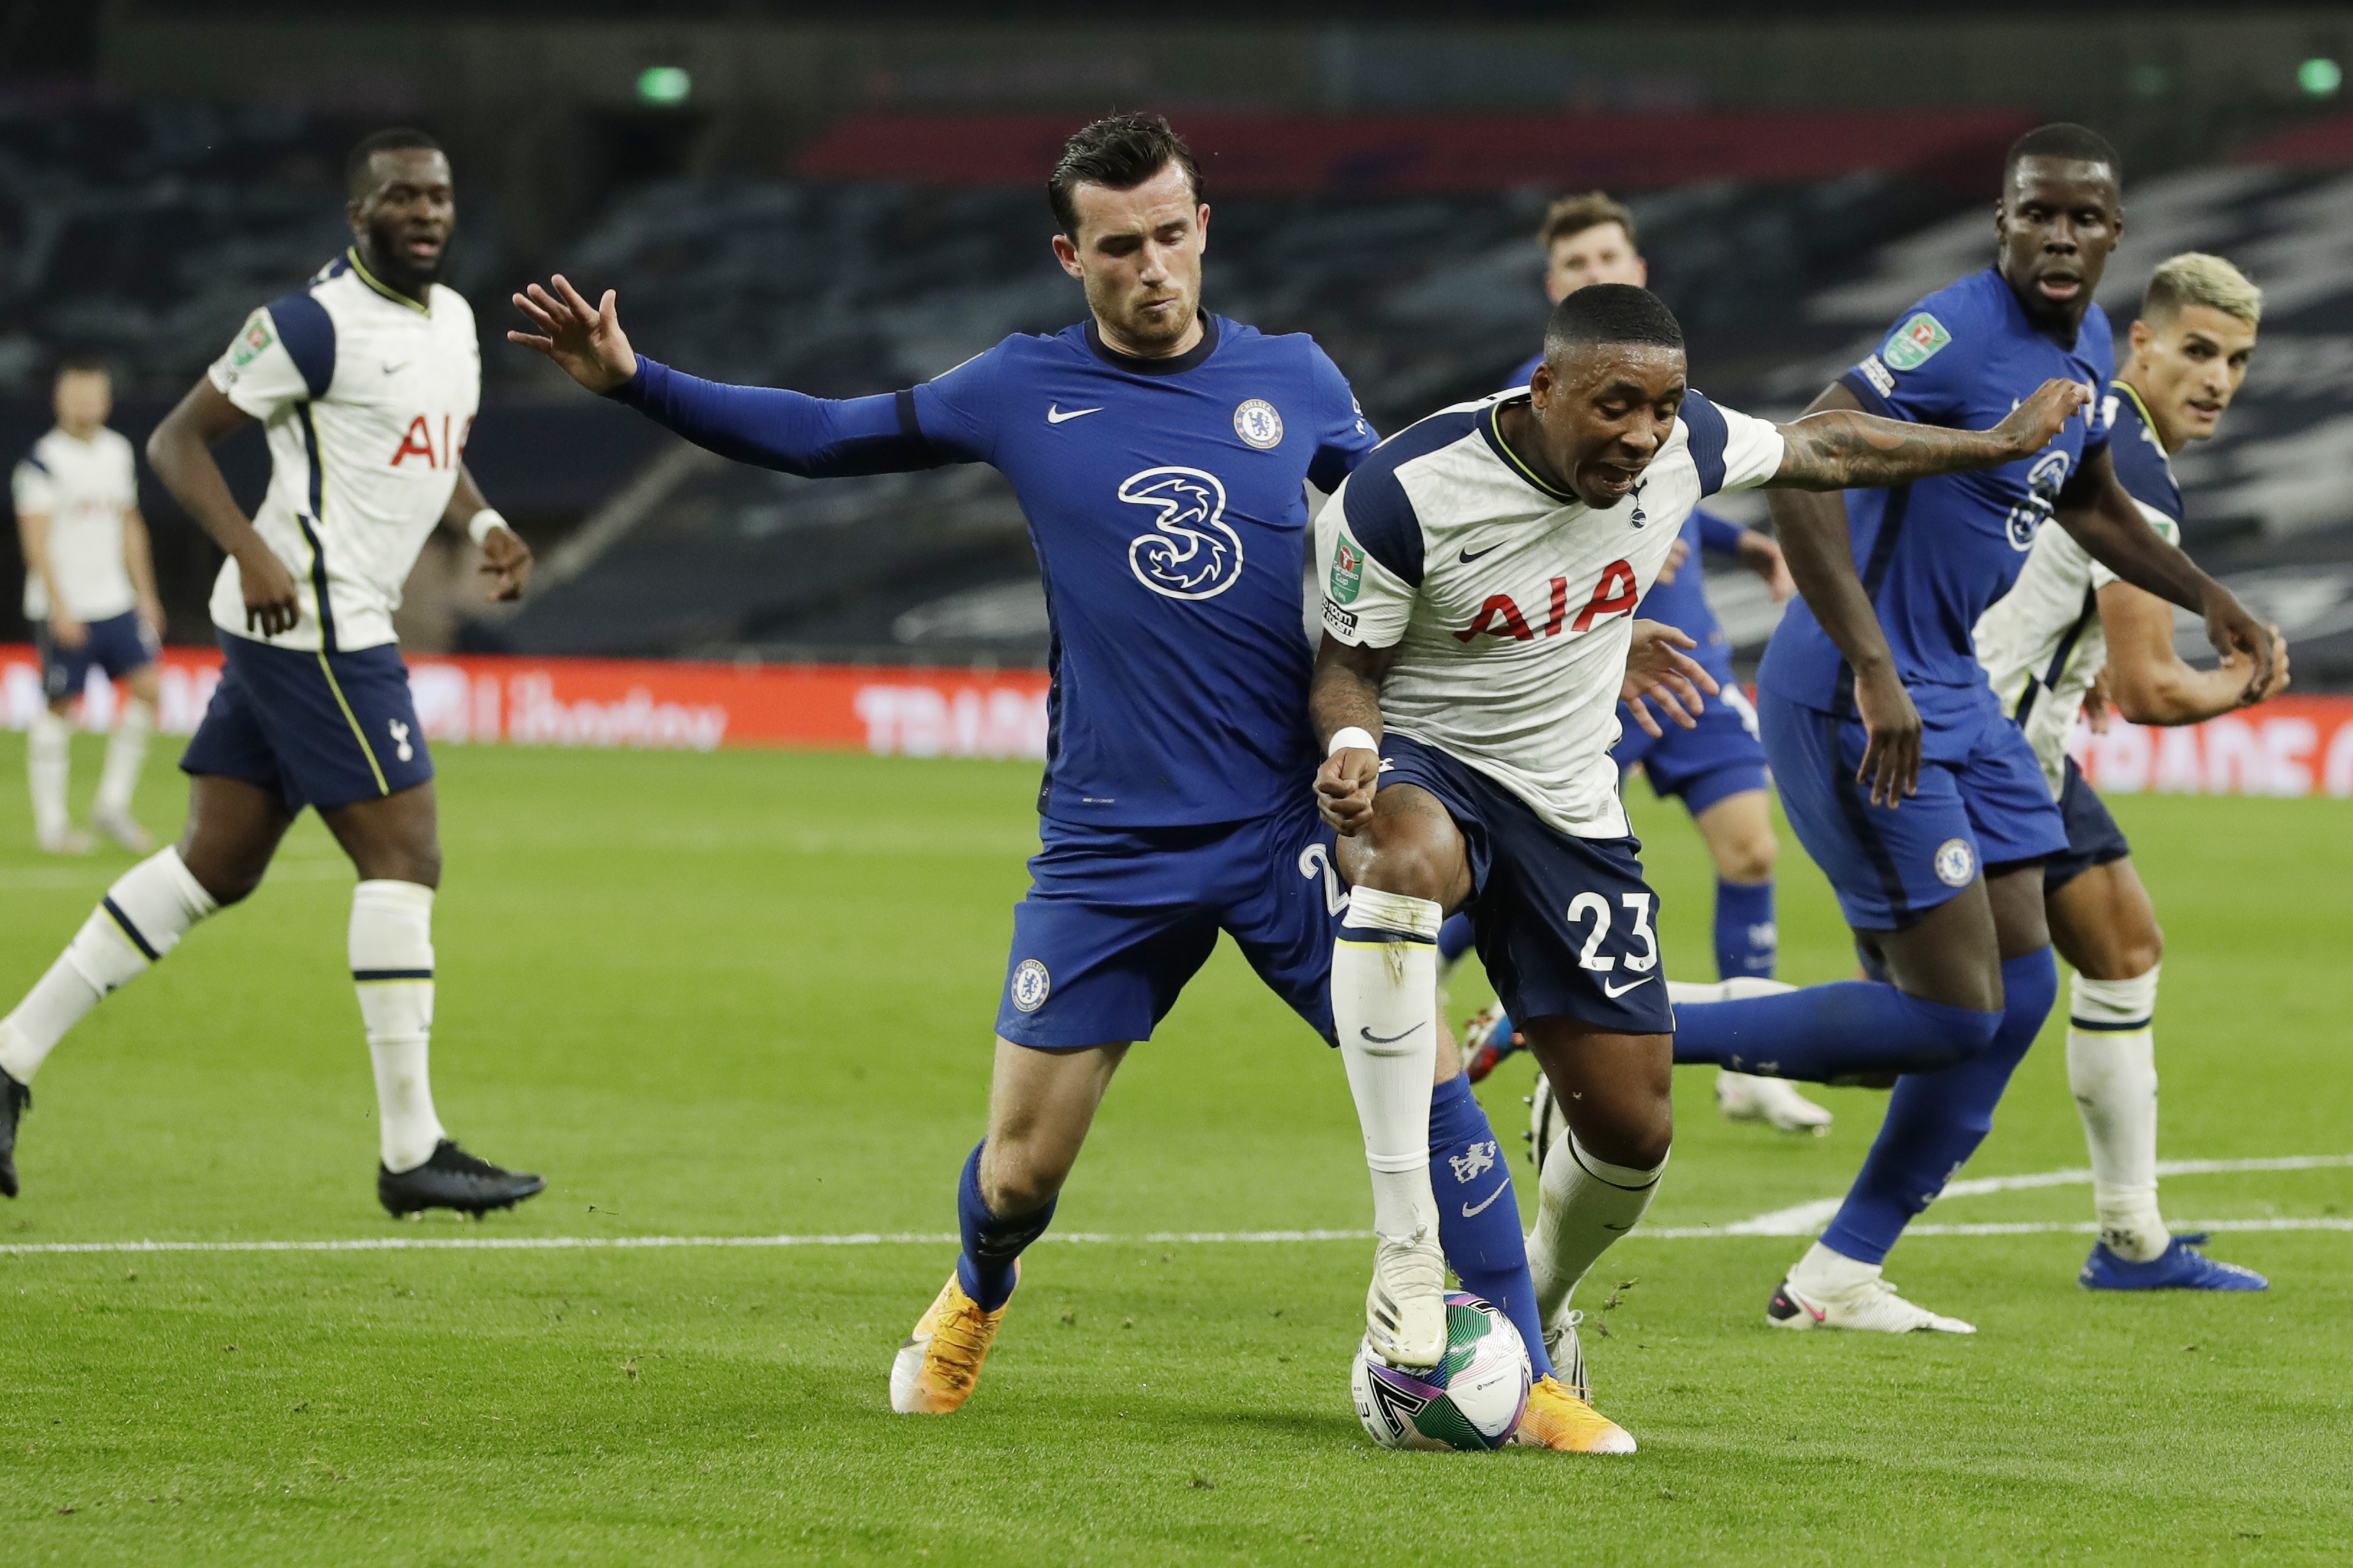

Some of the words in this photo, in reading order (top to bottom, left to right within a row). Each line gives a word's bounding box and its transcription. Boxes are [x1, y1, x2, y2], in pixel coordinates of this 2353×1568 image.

[1240, 401, 1271, 412] CHELSEA
[1452, 559, 1638, 643] AIA
[1567, 891, 1658, 972] 23
